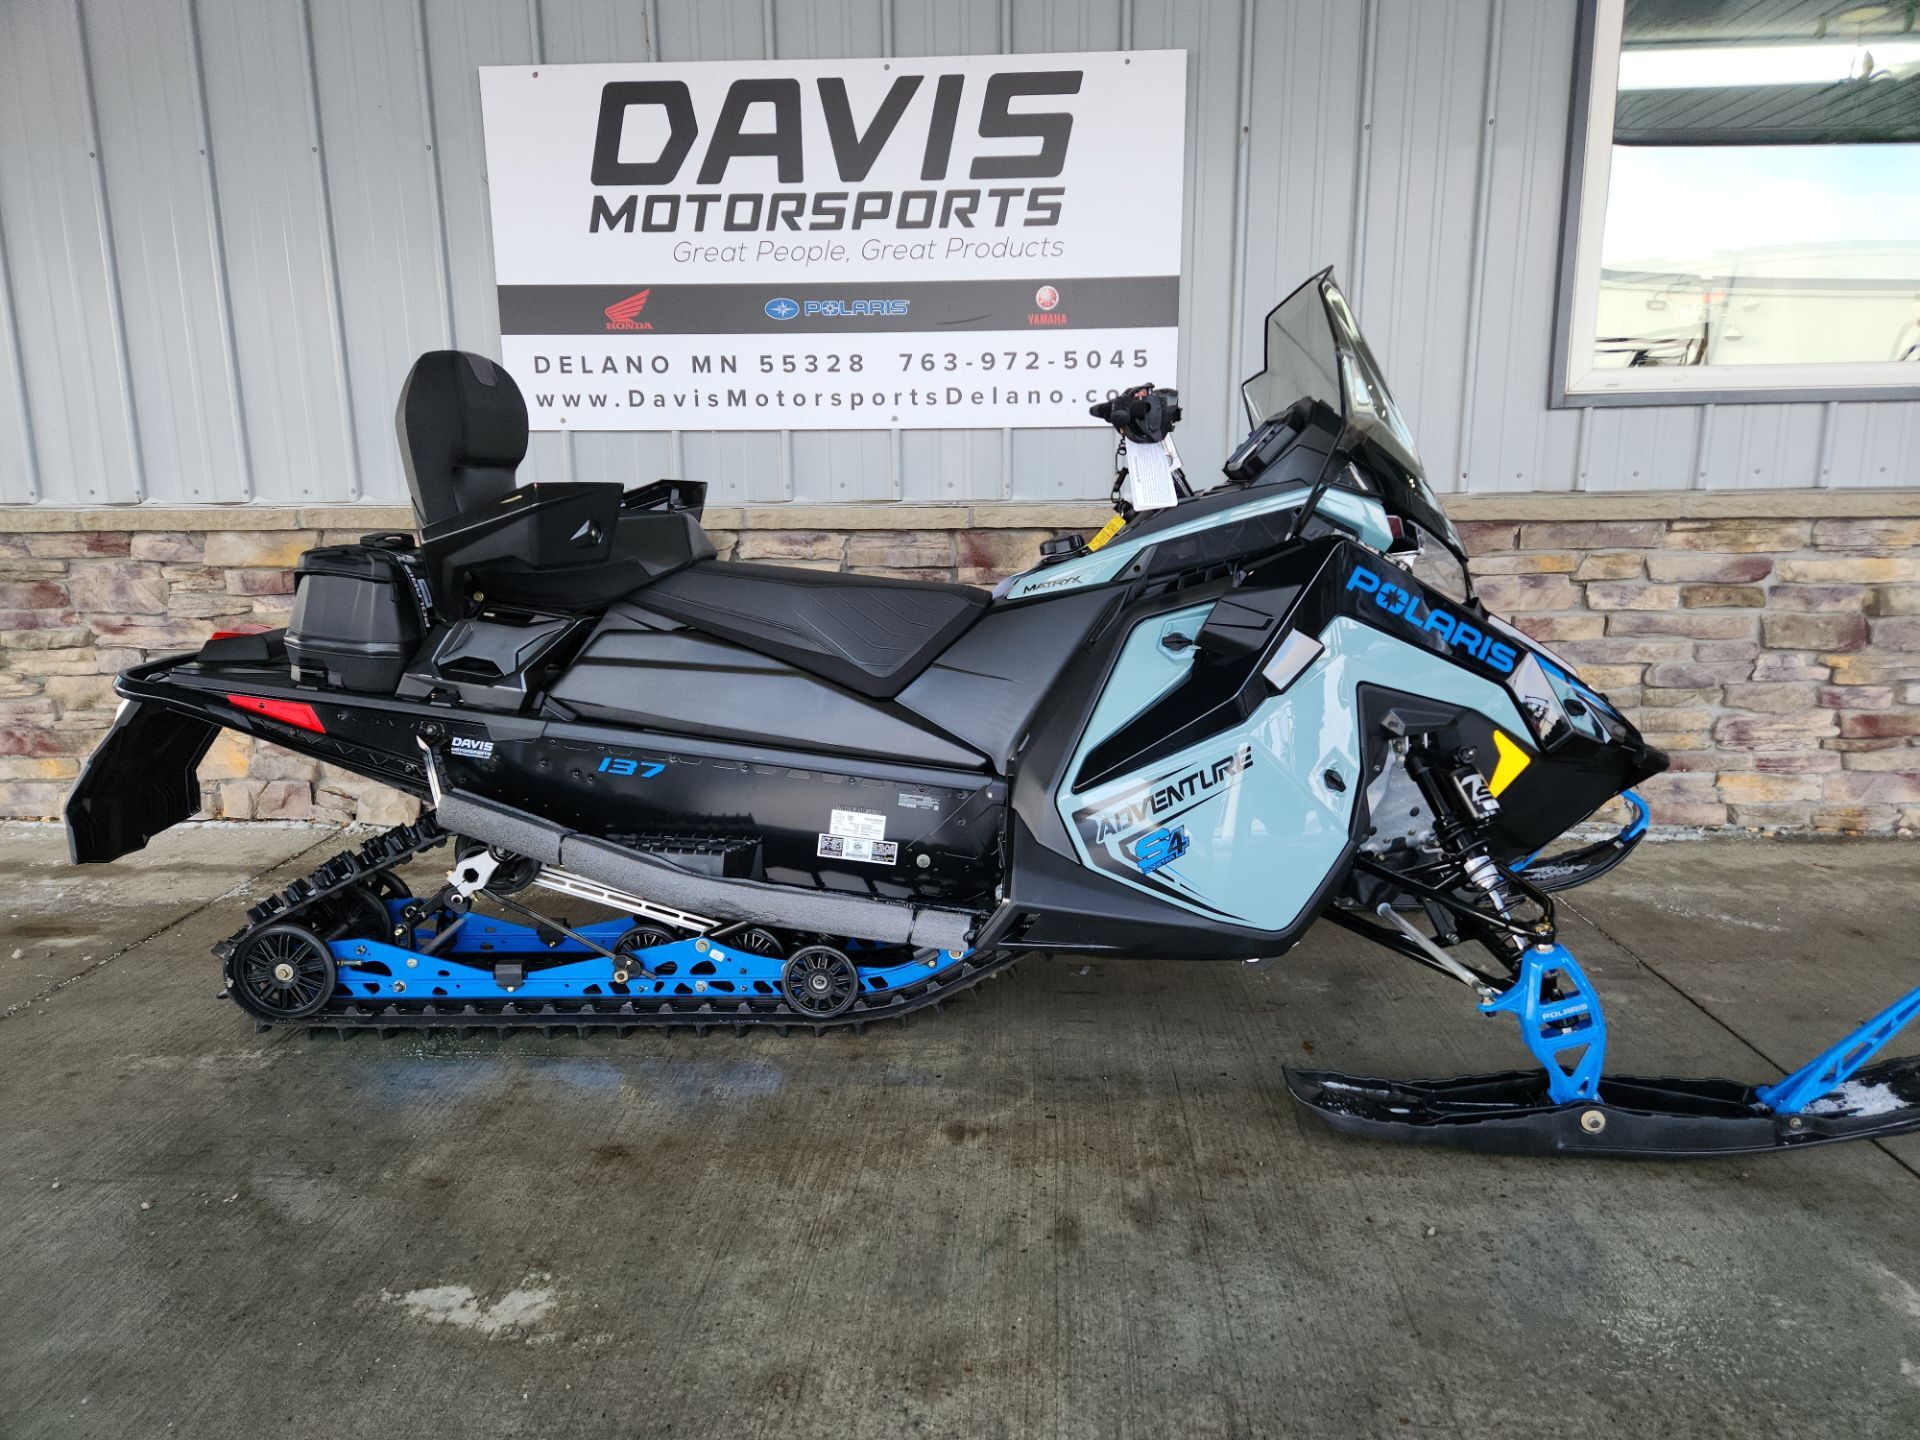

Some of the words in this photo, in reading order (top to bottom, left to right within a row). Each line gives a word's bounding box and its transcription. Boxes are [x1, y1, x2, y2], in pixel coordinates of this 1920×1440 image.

[591, 70, 1083, 186] DAVIS
[589, 187, 1065, 233] MOTORSPORTS
[673, 241, 747, 263] Great
[756, 239, 850, 267] People,
[861, 238, 937, 261] Great
[945, 236, 1064, 260] Products
[804, 299, 908, 317] POLARIS
[1027, 313, 1067, 325] YAMAHA
[606, 322, 653, 330] HONDA
[534, 355, 669, 374] DELANO
[691, 355, 737, 374] MN
[759, 354, 864, 373] 55328
[899, 350, 1148, 372] 763-972-5045
[535, 387, 1119, 411] www.DavisMotorsportsDelano.co
[1023, 576, 1083, 594] MATRYX
[1346, 565, 1518, 673] POLARIS
[451, 736, 494, 751] DAVIS
[598, 757, 666, 779] 137
[1096, 745, 1254, 844] ADVENTURE
[1135, 825, 1190, 870] S4
[1542, 1003, 1588, 1020] POLARIS
